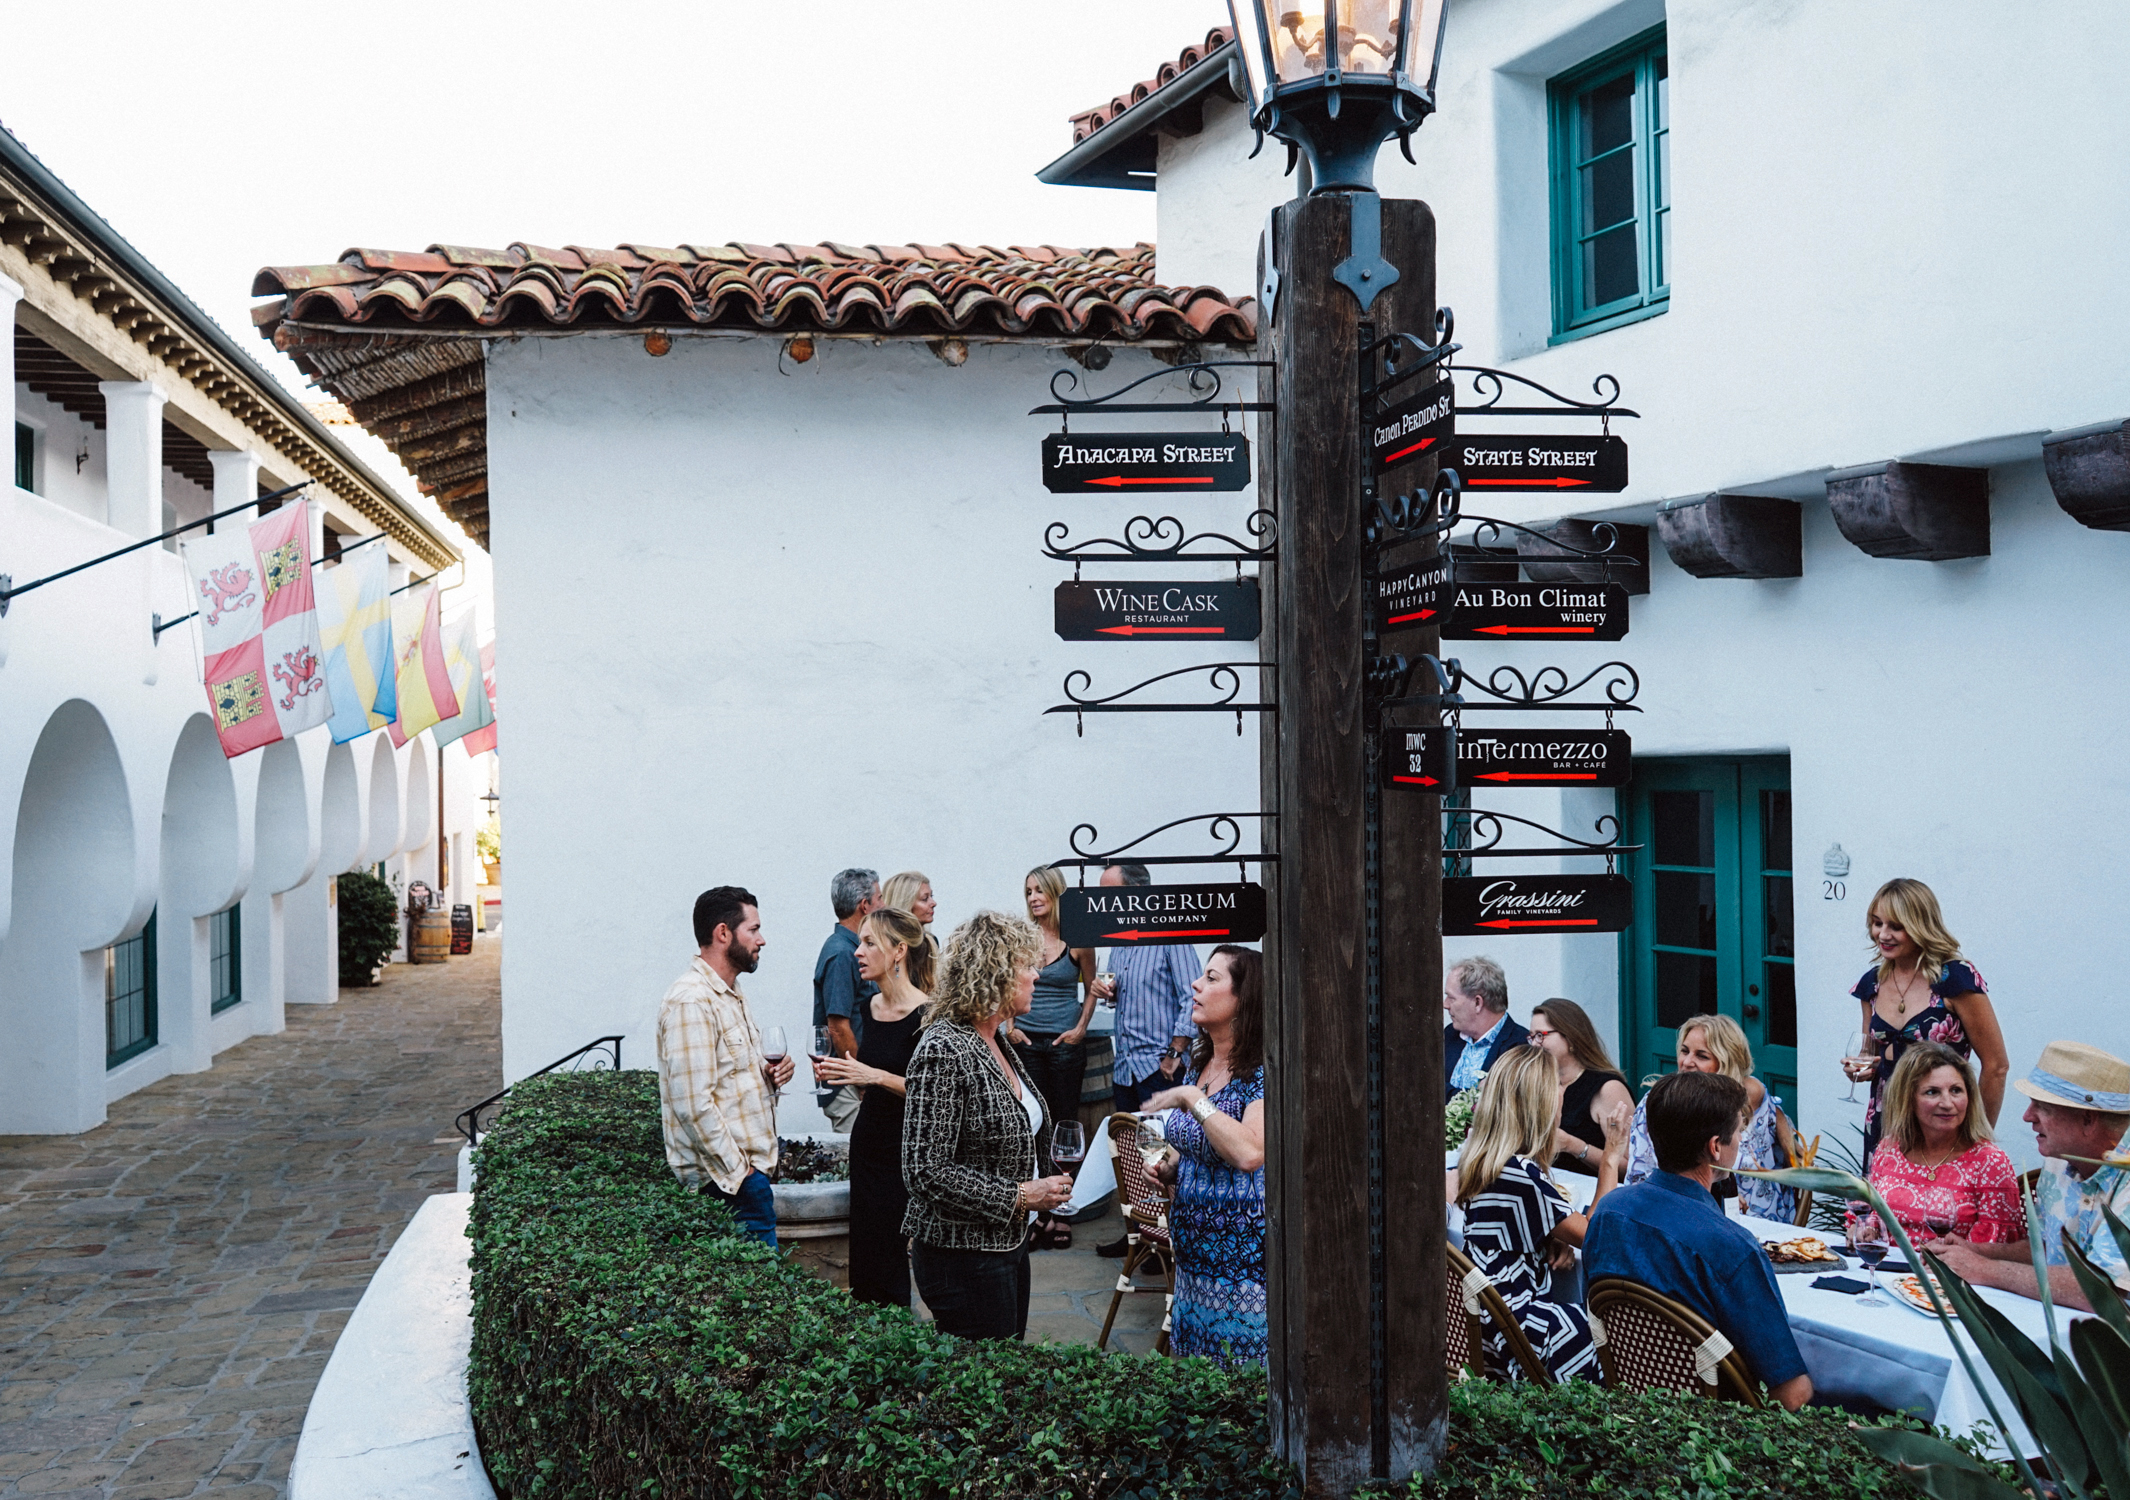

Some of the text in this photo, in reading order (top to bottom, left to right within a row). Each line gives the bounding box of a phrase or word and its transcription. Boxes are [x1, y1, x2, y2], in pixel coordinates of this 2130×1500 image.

[1389, 590, 1436, 611] VINEYARD
[1454, 588, 1607, 607] Au Bon Climat
[1124, 614, 1189, 623] RESTAURANT
[1560, 609, 1607, 626] winery
[1409, 753, 1422, 773] 32
[1553, 761, 1571, 769] BAR
[1583, 760, 1606, 769] CAFÉ
[1479, 880, 1587, 918] Grassini
[1822, 880, 1846, 901] 20
[1086, 892, 1237, 913] MARGERUM
[1116, 914, 1208, 925] WINE COMPANY
